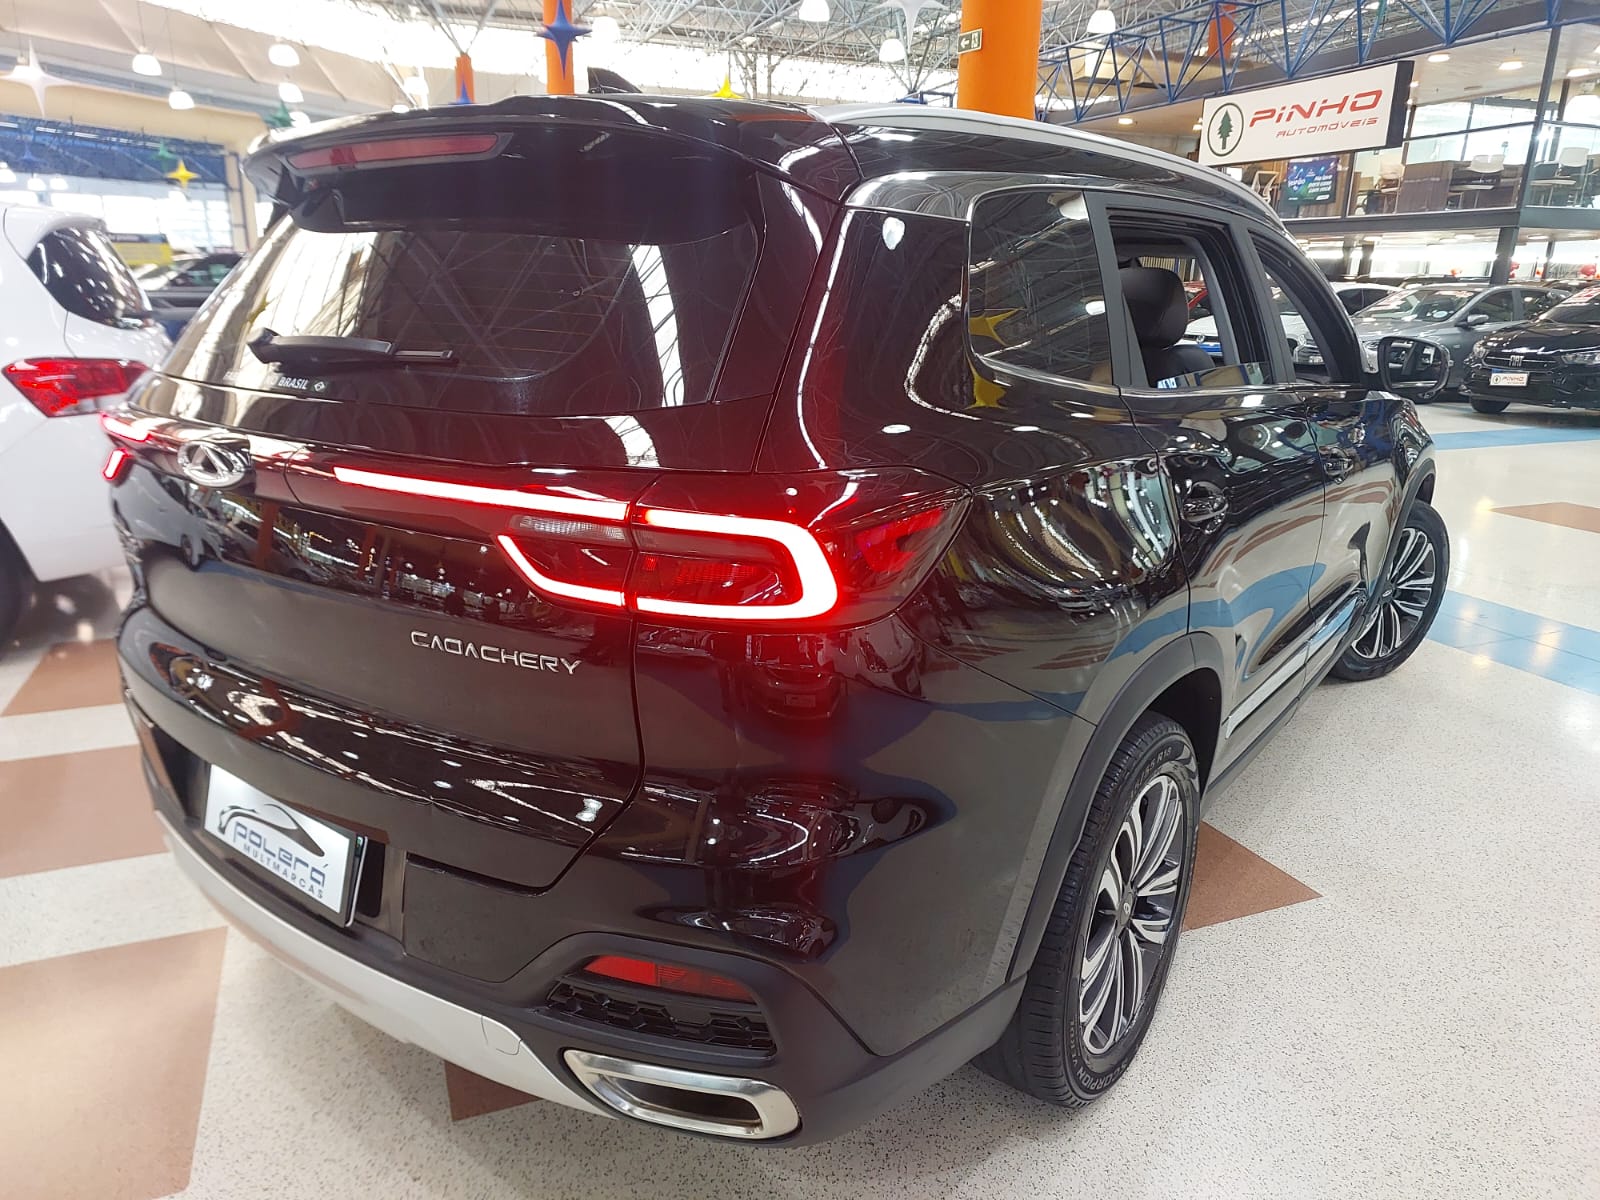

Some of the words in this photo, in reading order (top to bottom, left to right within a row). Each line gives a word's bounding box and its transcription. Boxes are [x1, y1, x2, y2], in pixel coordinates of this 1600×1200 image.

[1250, 89, 1383, 127] PINHO
[1276, 117, 1378, 138] AUTOMÓVEIS
[1509, 355, 1524, 367] FIAT
[278, 376, 309, 390] BRASIL
[1077, 1058, 1128, 1090] SCORPION
